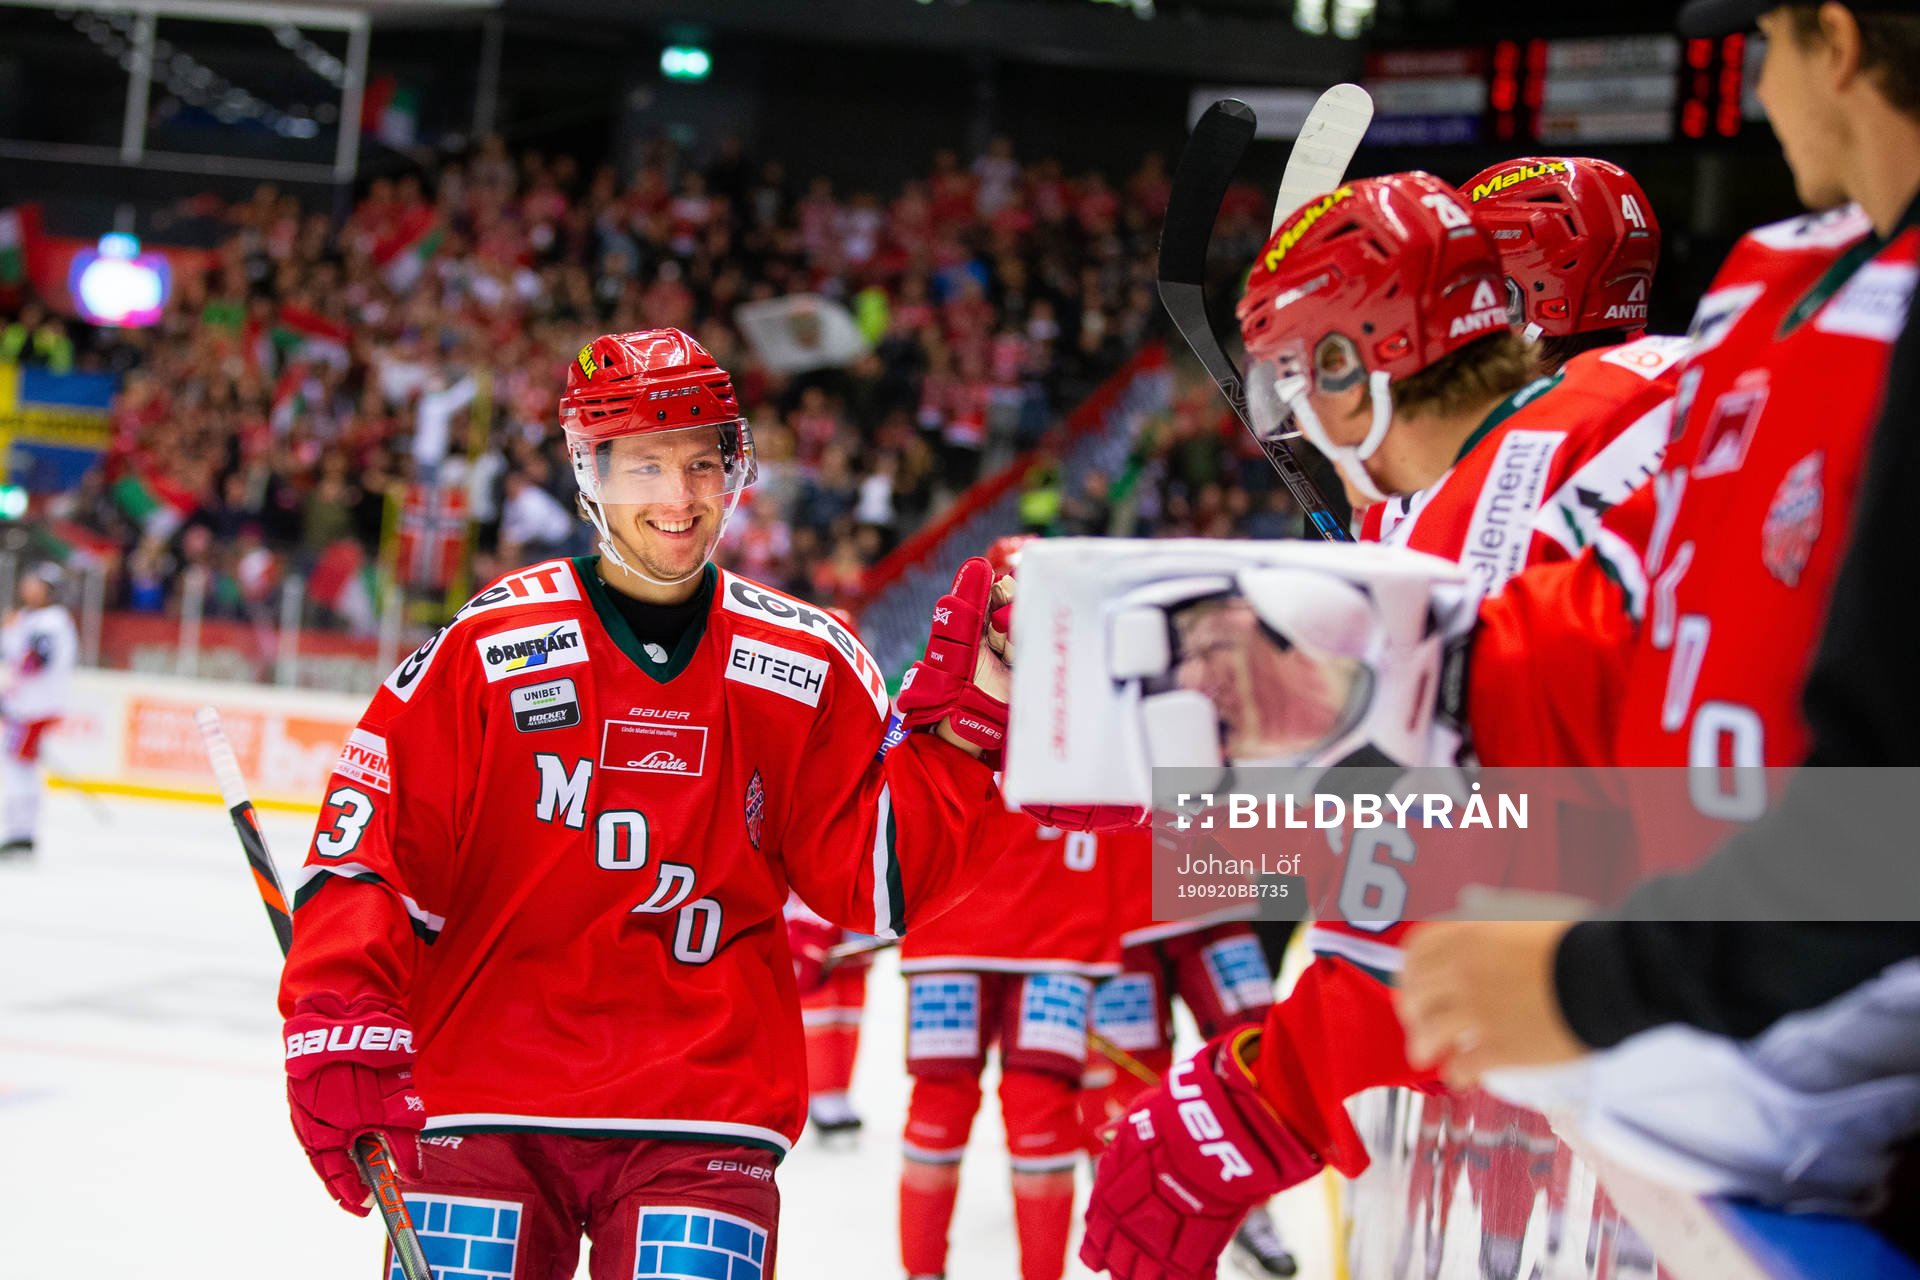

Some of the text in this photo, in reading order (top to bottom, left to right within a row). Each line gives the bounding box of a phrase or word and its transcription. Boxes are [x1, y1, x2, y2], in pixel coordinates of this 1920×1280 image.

[1472, 160, 1568, 203] Malux
[1263, 185, 1354, 273] Malux
[1620, 194, 1648, 229] 41
[486, 631, 580, 667] ÖRNFRAKT
[729, 581, 887, 696] coreIT
[523, 686, 561, 701] UNIBET
[528, 709, 567, 722] HOCKEY
[628, 707, 691, 721] BAUER
[959, 718, 1003, 740] BAUER
[626, 750, 688, 771] Linde
[314, 785, 376, 859] 3
[532, 751, 723, 966] MODO
[286, 1025, 415, 1060] BAUER
[706, 1160, 773, 1183] BAUER
